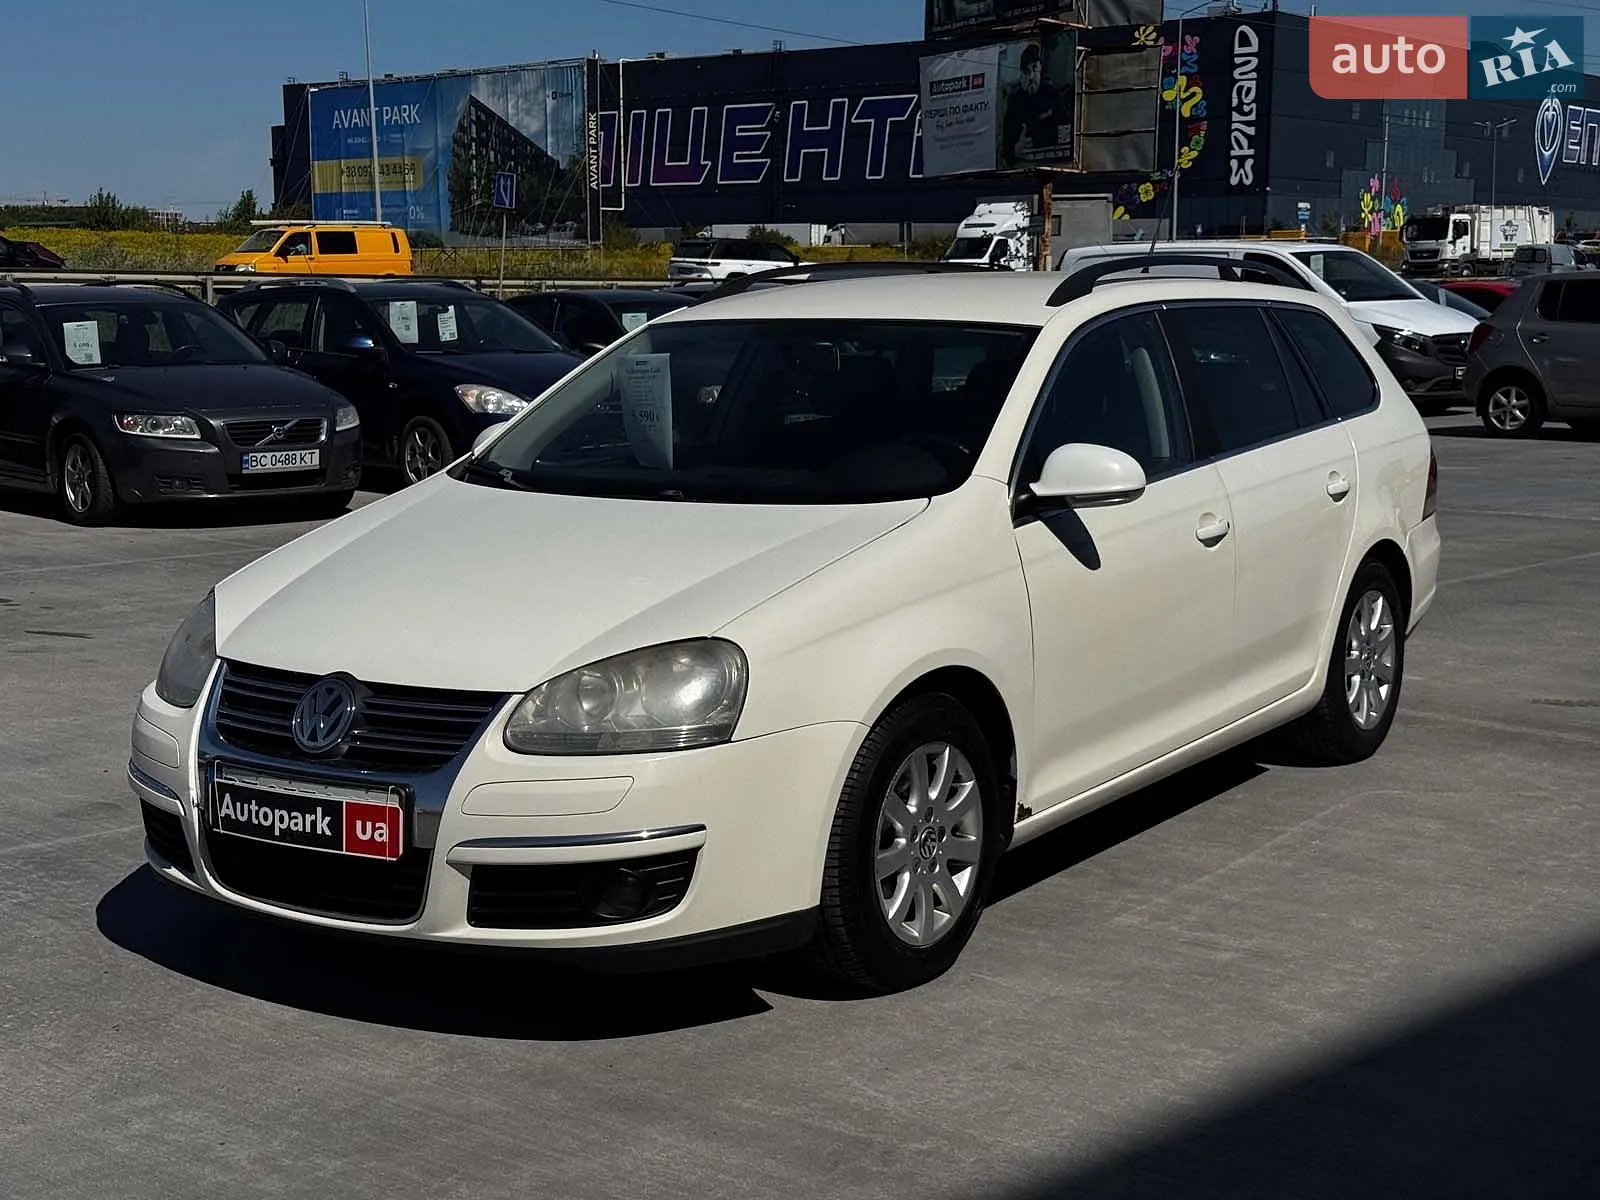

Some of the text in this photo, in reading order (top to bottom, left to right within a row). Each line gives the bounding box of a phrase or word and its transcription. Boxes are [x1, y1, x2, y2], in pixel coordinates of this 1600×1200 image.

[383, 103, 421, 126] PARK
[588, 111, 599, 191] AVANT PARK
[599, 95, 923, 187] ІЦЕНТ
[250, 451, 316, 468] BC 0488 KT
[220, 792, 389, 843] Autopark ua
